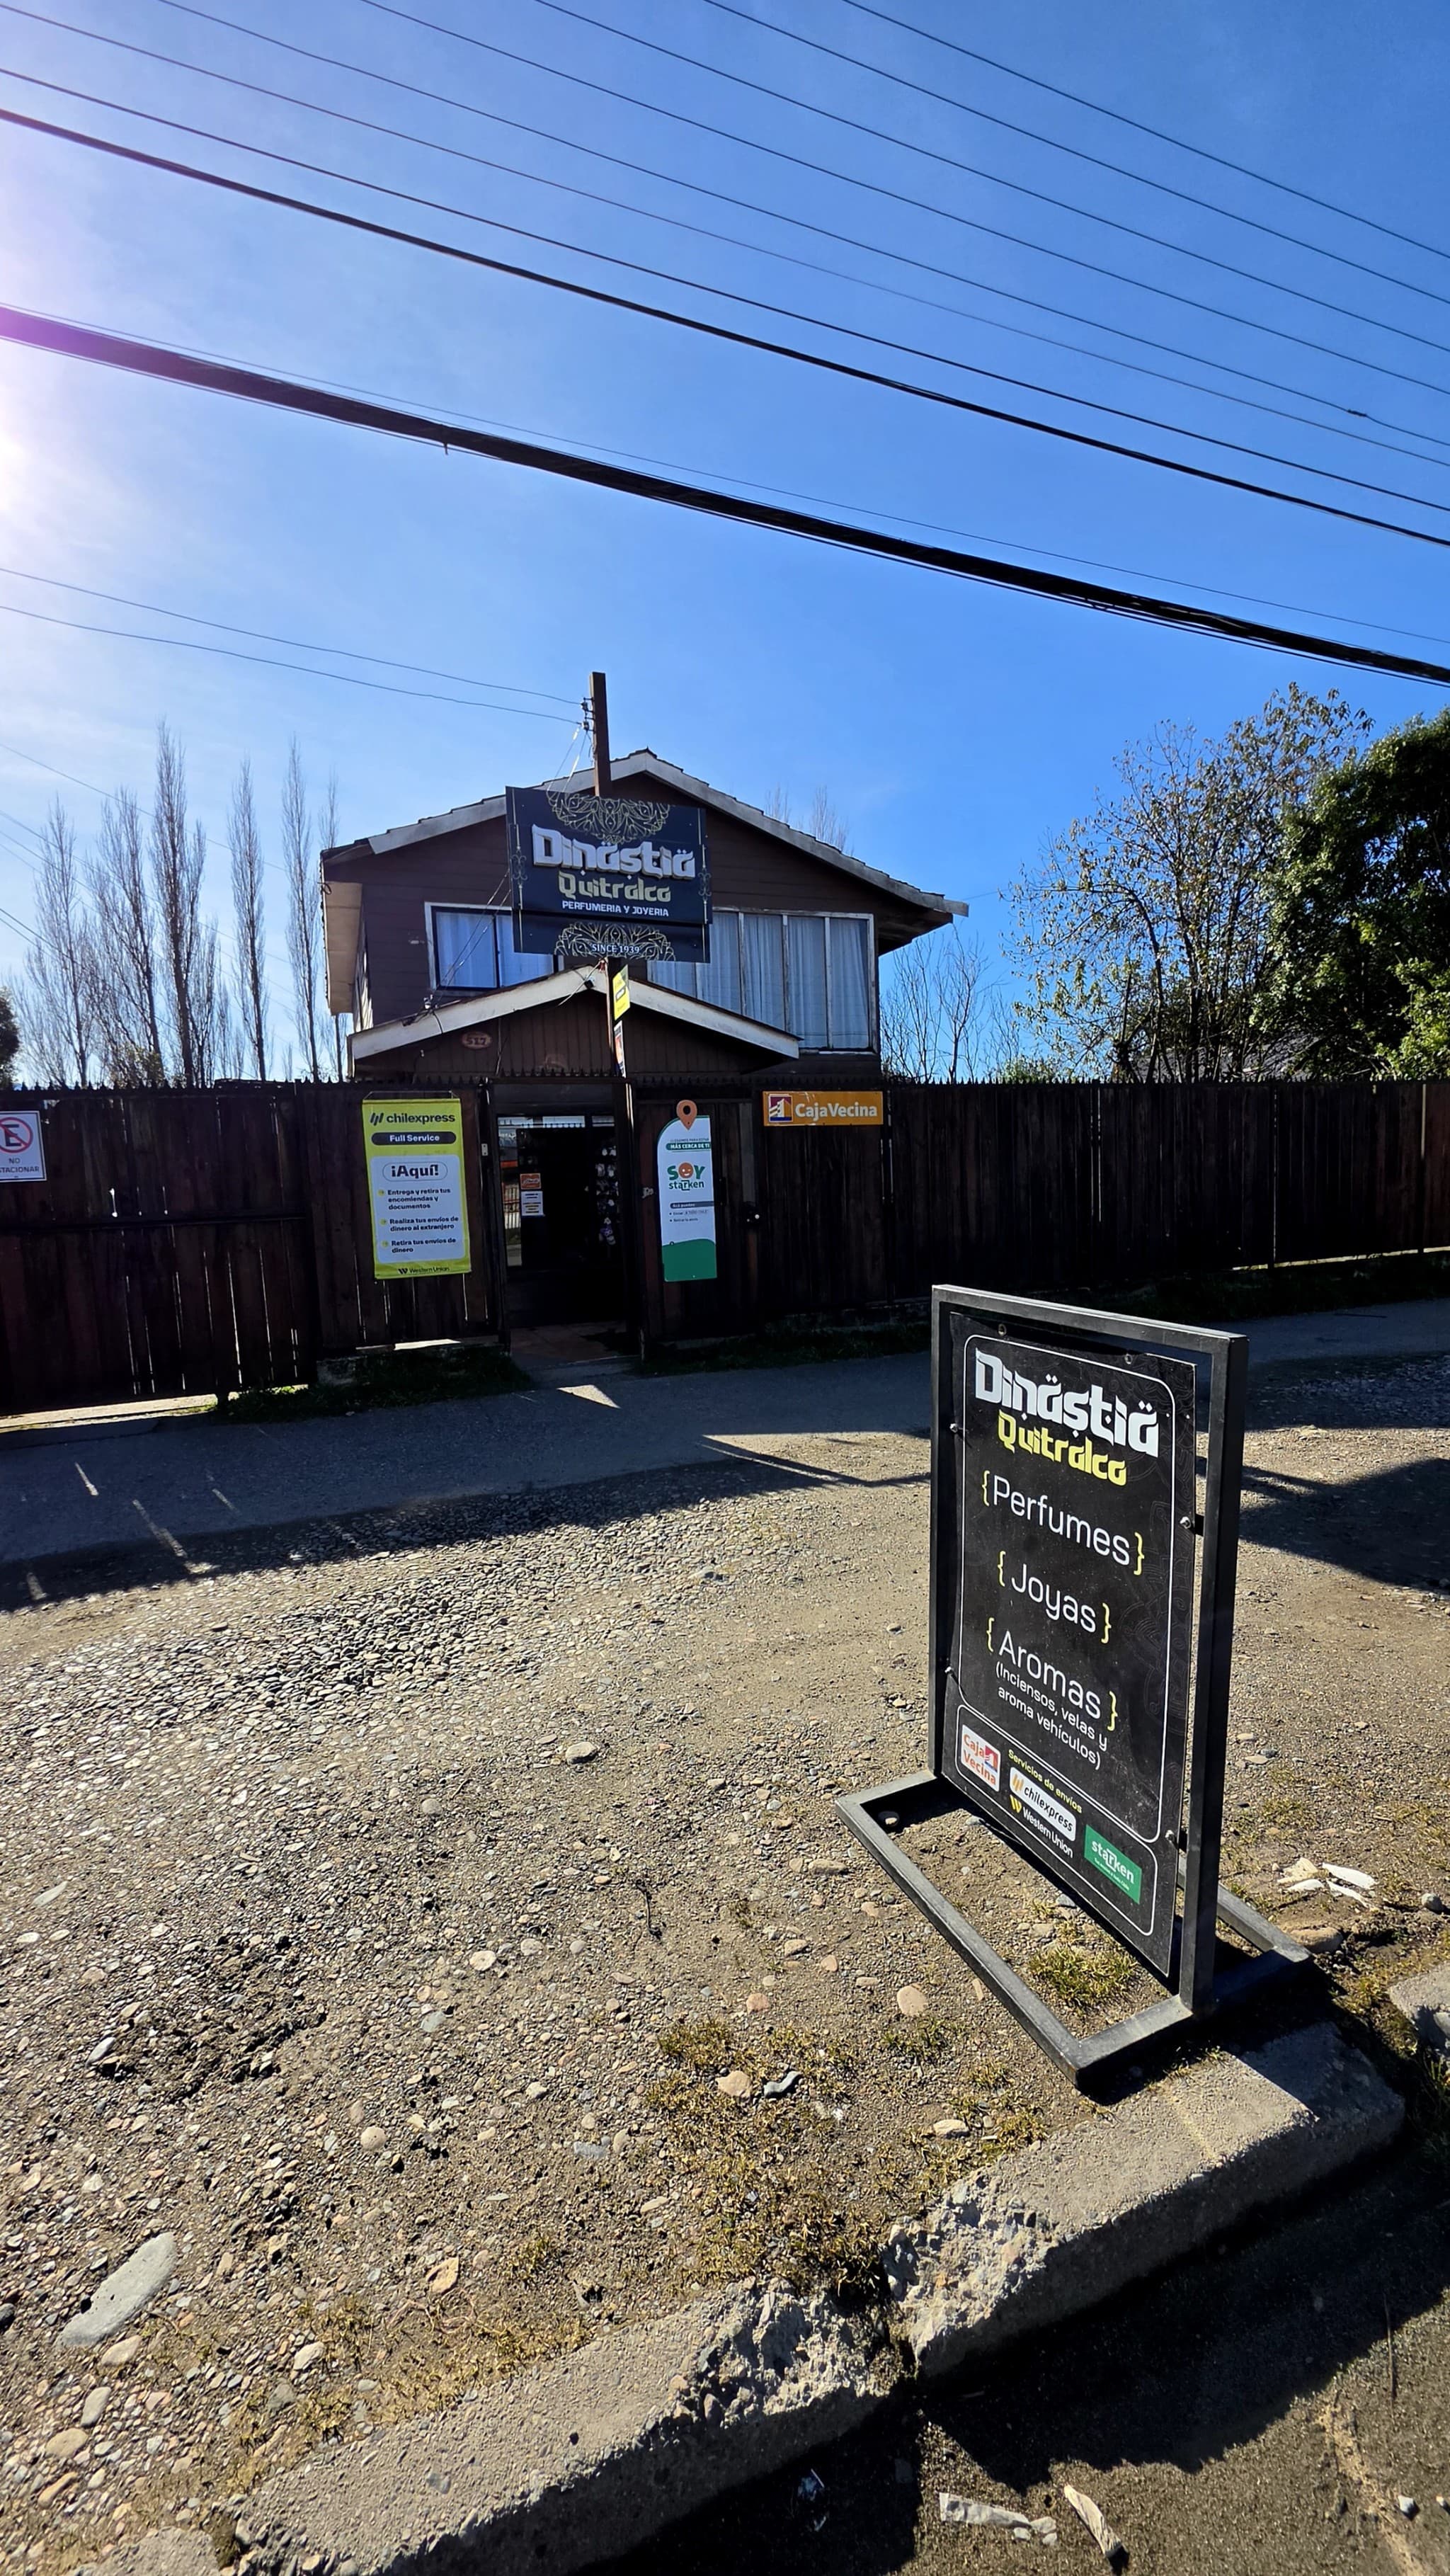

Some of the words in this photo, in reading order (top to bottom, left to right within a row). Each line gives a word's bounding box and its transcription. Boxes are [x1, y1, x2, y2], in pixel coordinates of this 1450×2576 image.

[562, 900, 622, 913] PERFUMERIA
[632, 906, 669, 916] JOYERIA
[592, 943, 617, 953] SINCE
[620, 945, 639, 954] 1939
[386, 1112, 455, 1124] chilexpress
[391, 1164, 439, 1179] ¡Aquí!
[668, 1180, 704, 1191] starken
[995, 1661, 1058, 1716] (Inciensos,
[1061, 1707, 1095, 1740] velas
[1099, 1733, 1107, 1752] y
[998, 1686, 1034, 1719] aroma
[963, 1734, 984, 1757] Caja
[963, 1749, 996, 1786] Vecina
[1008, 1749, 1043, 1782] Servicios
[1044, 1779, 1054, 1791] de
[1024, 1786, 1073, 1833] chilexpress
[1092, 1840, 1134, 1883] starken
